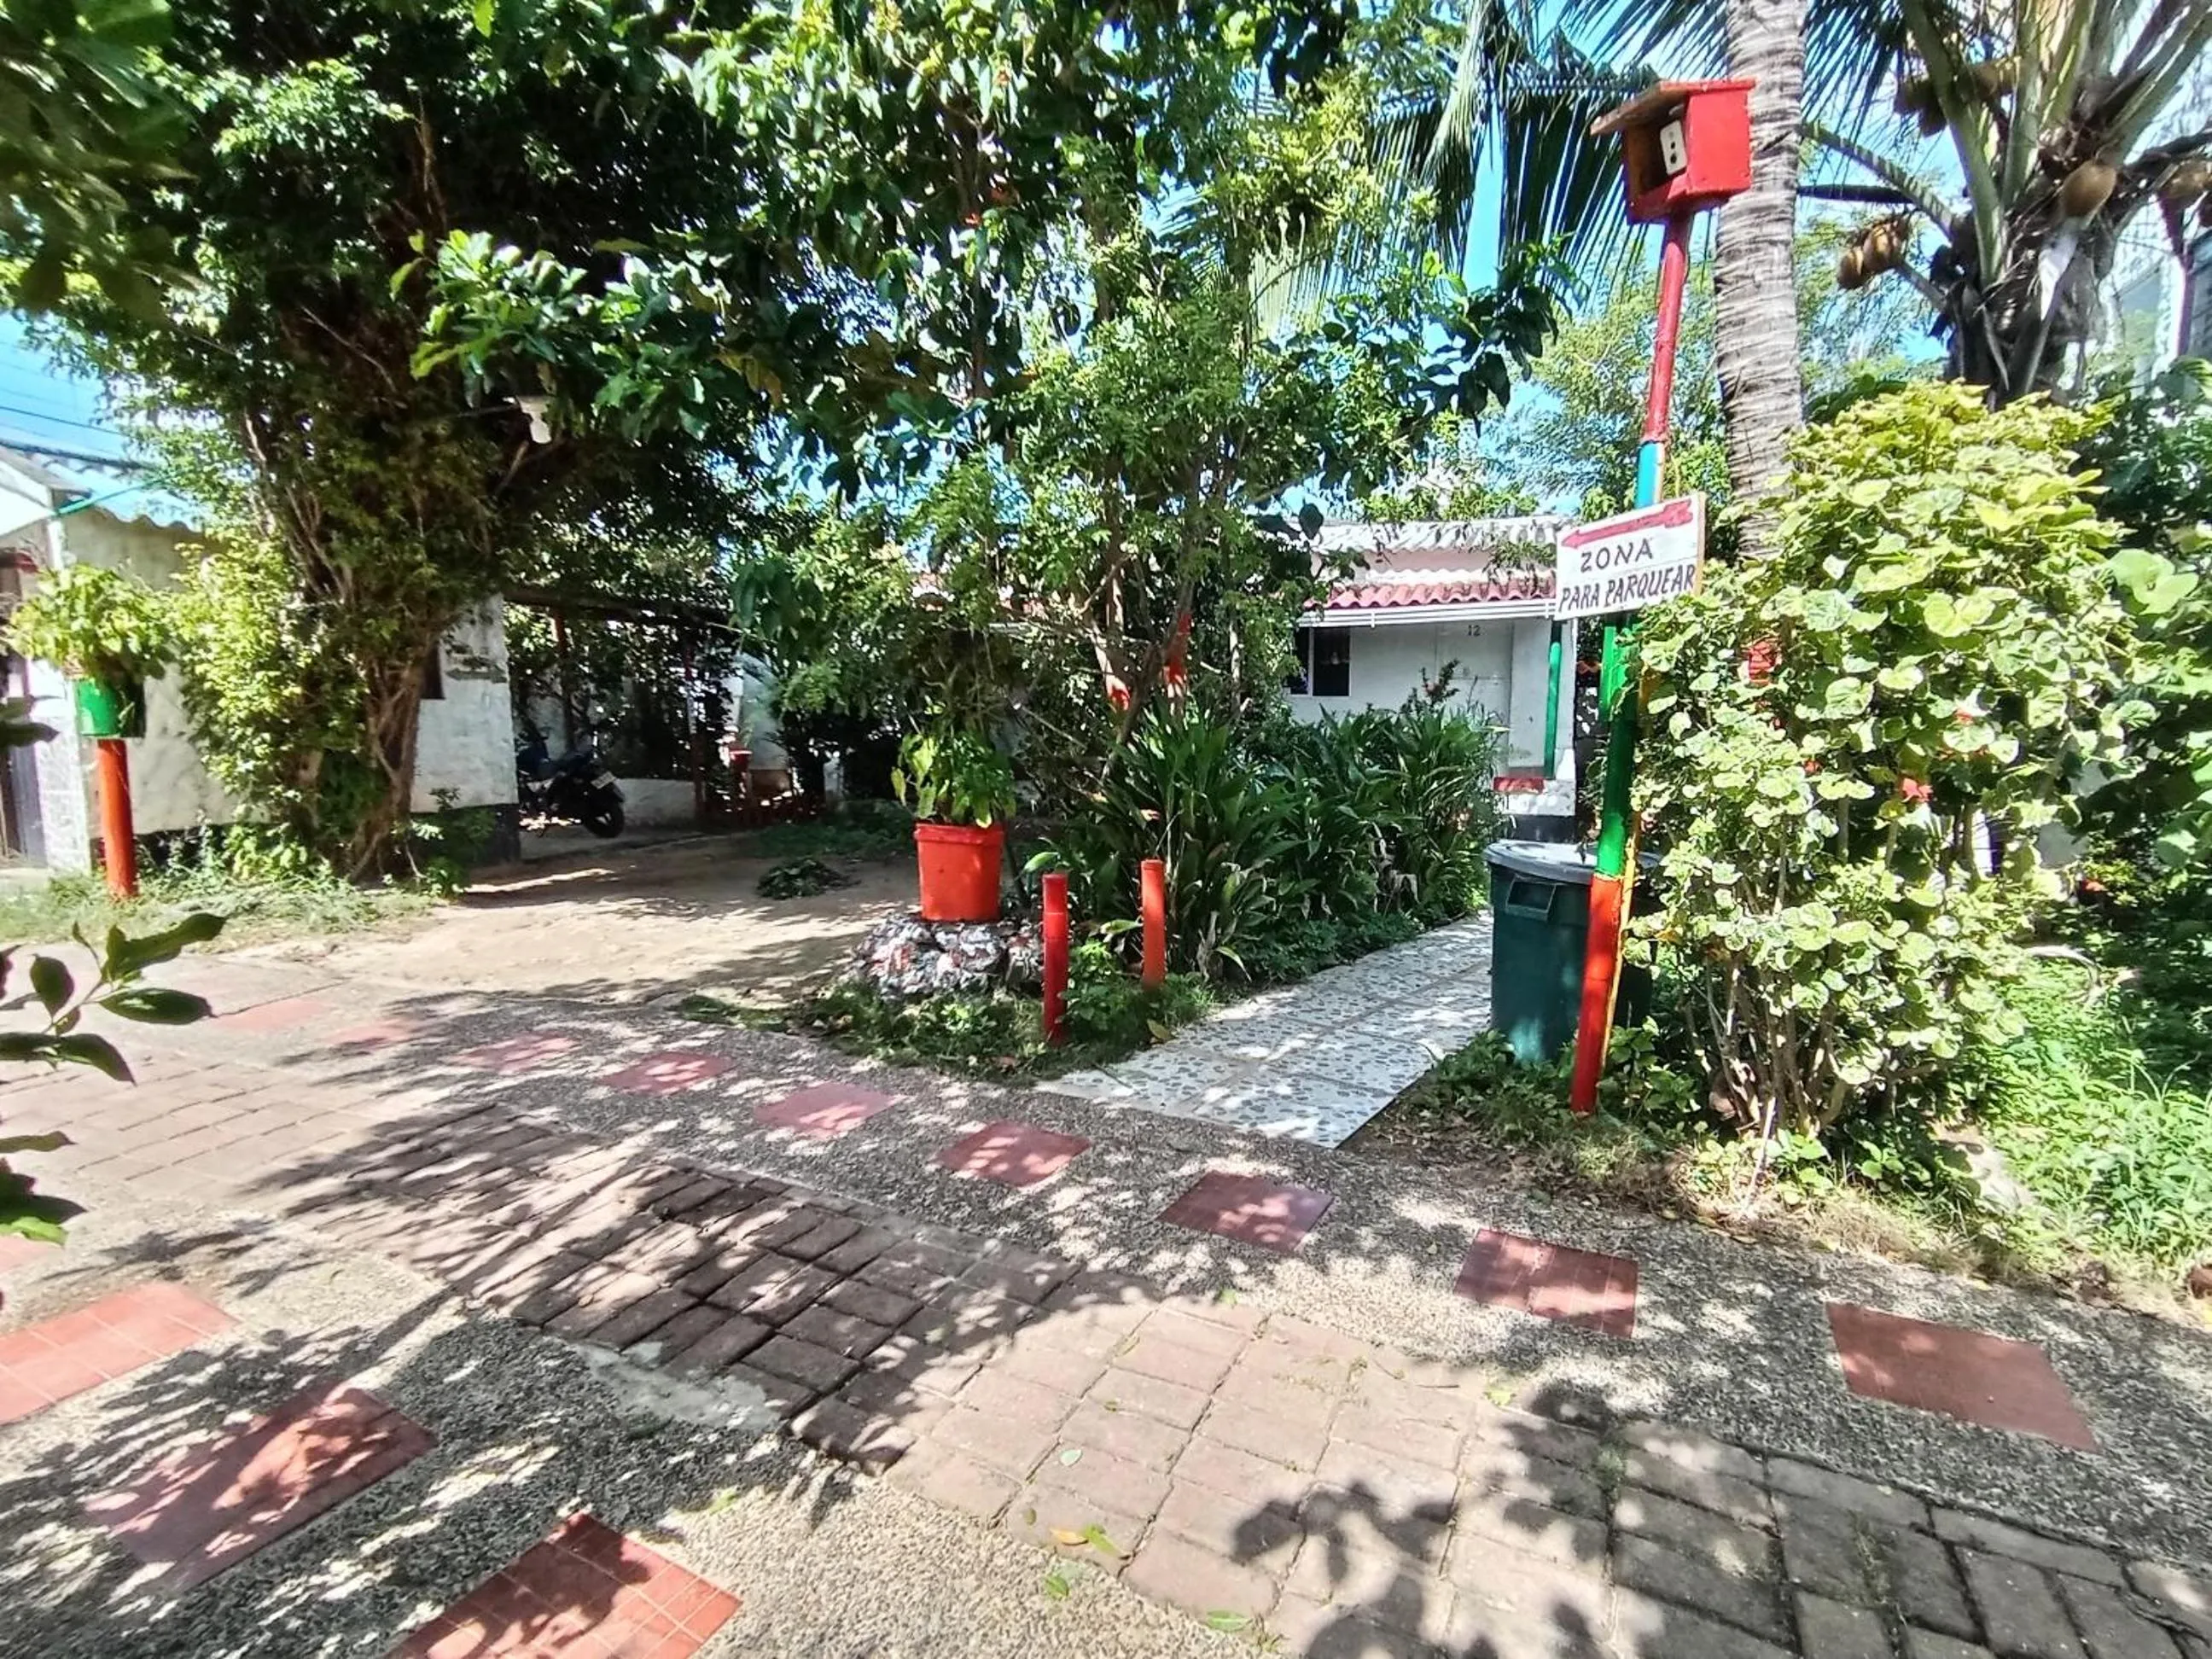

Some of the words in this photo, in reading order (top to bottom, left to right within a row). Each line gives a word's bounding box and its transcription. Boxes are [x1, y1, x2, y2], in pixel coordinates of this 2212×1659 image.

[1580, 538, 1653, 573] ZONA
[1558, 583, 1600, 612] PARA
[1604, 564, 1696, 608] PARQUEAR
[1468, 624, 1481, 637] 12
